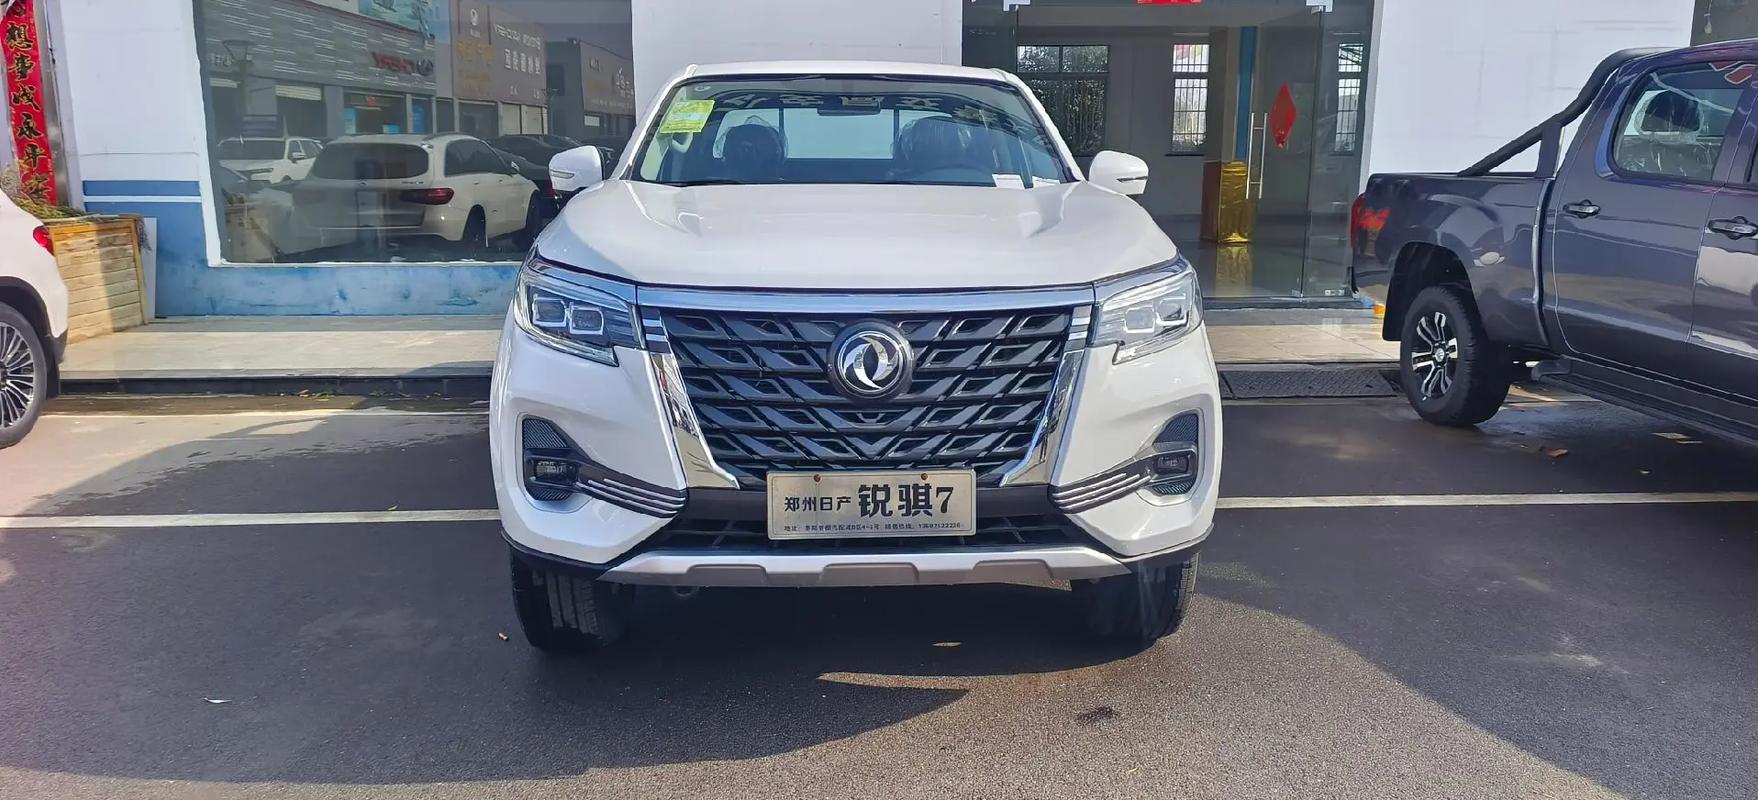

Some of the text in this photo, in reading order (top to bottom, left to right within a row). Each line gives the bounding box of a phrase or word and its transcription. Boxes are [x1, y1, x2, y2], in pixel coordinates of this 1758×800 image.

[785, 483, 954, 517] 郑州日产 锐骐7
